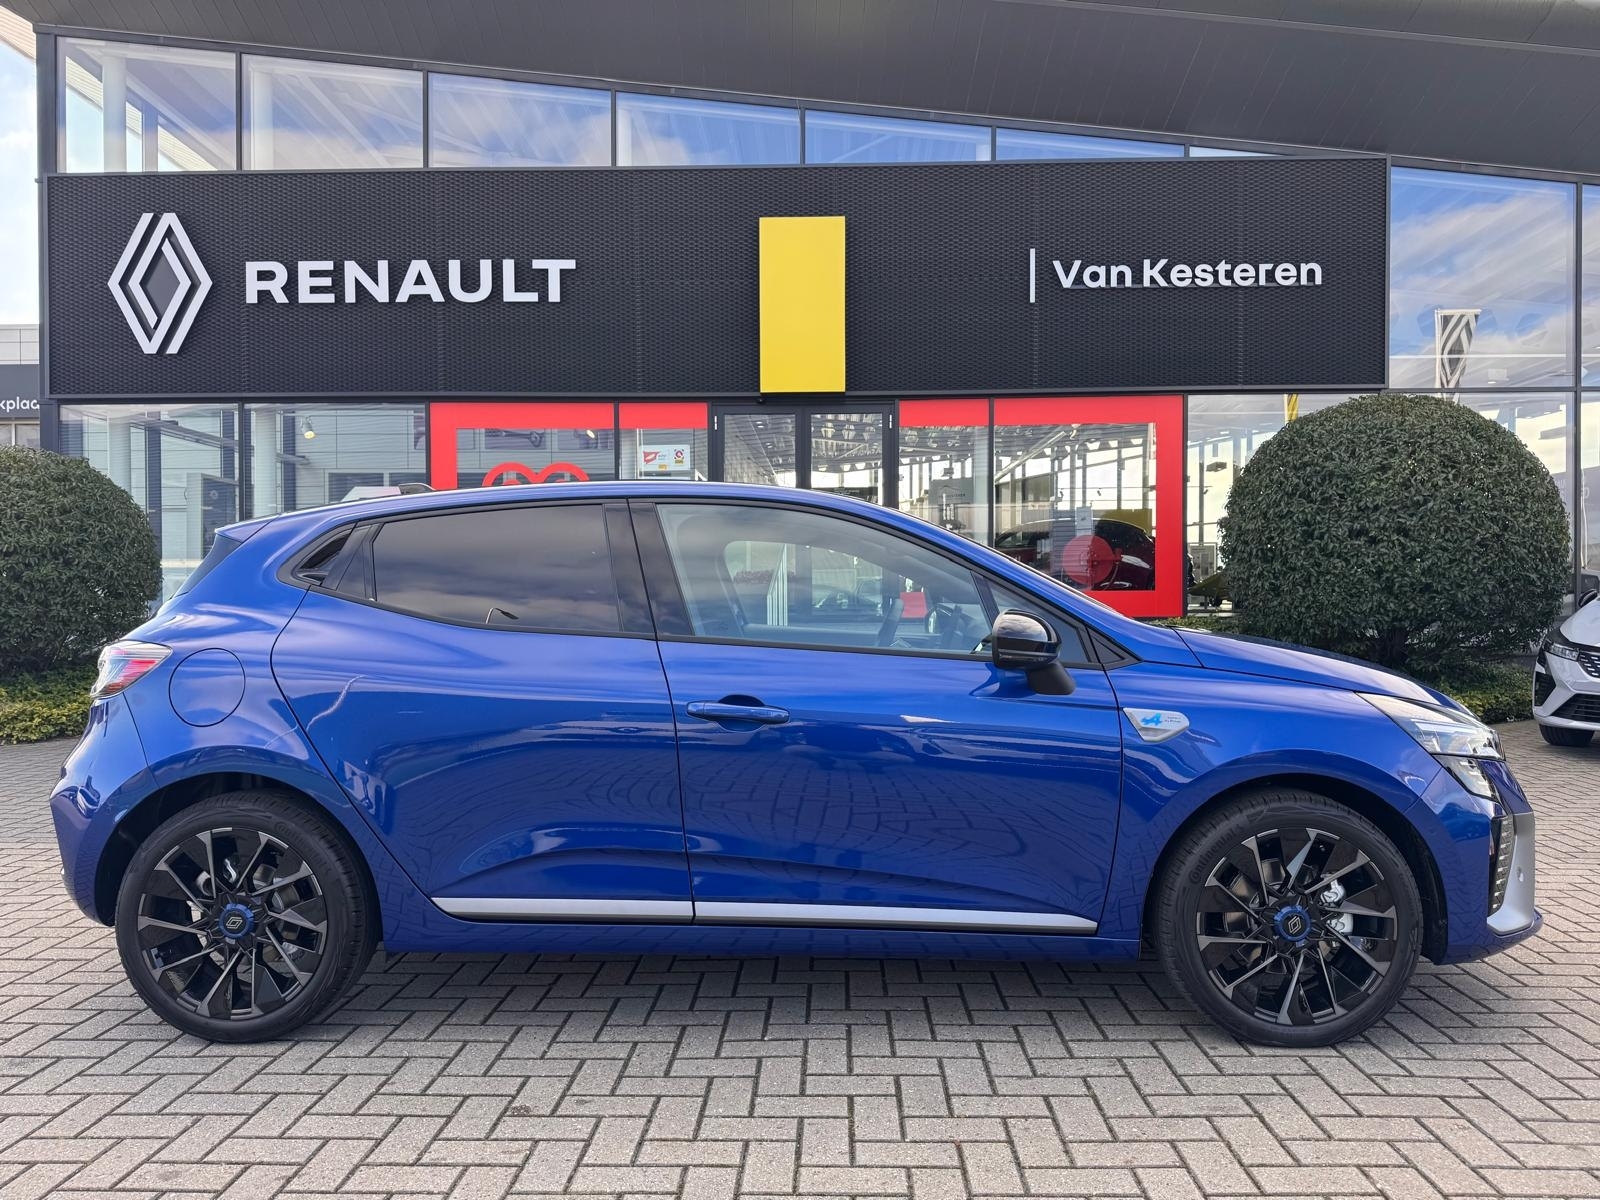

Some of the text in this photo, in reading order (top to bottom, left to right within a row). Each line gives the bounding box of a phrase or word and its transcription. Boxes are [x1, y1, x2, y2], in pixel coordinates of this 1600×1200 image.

[245, 259, 577, 304] RENAULT
[1052, 258, 1322, 289] Van Kesteren
